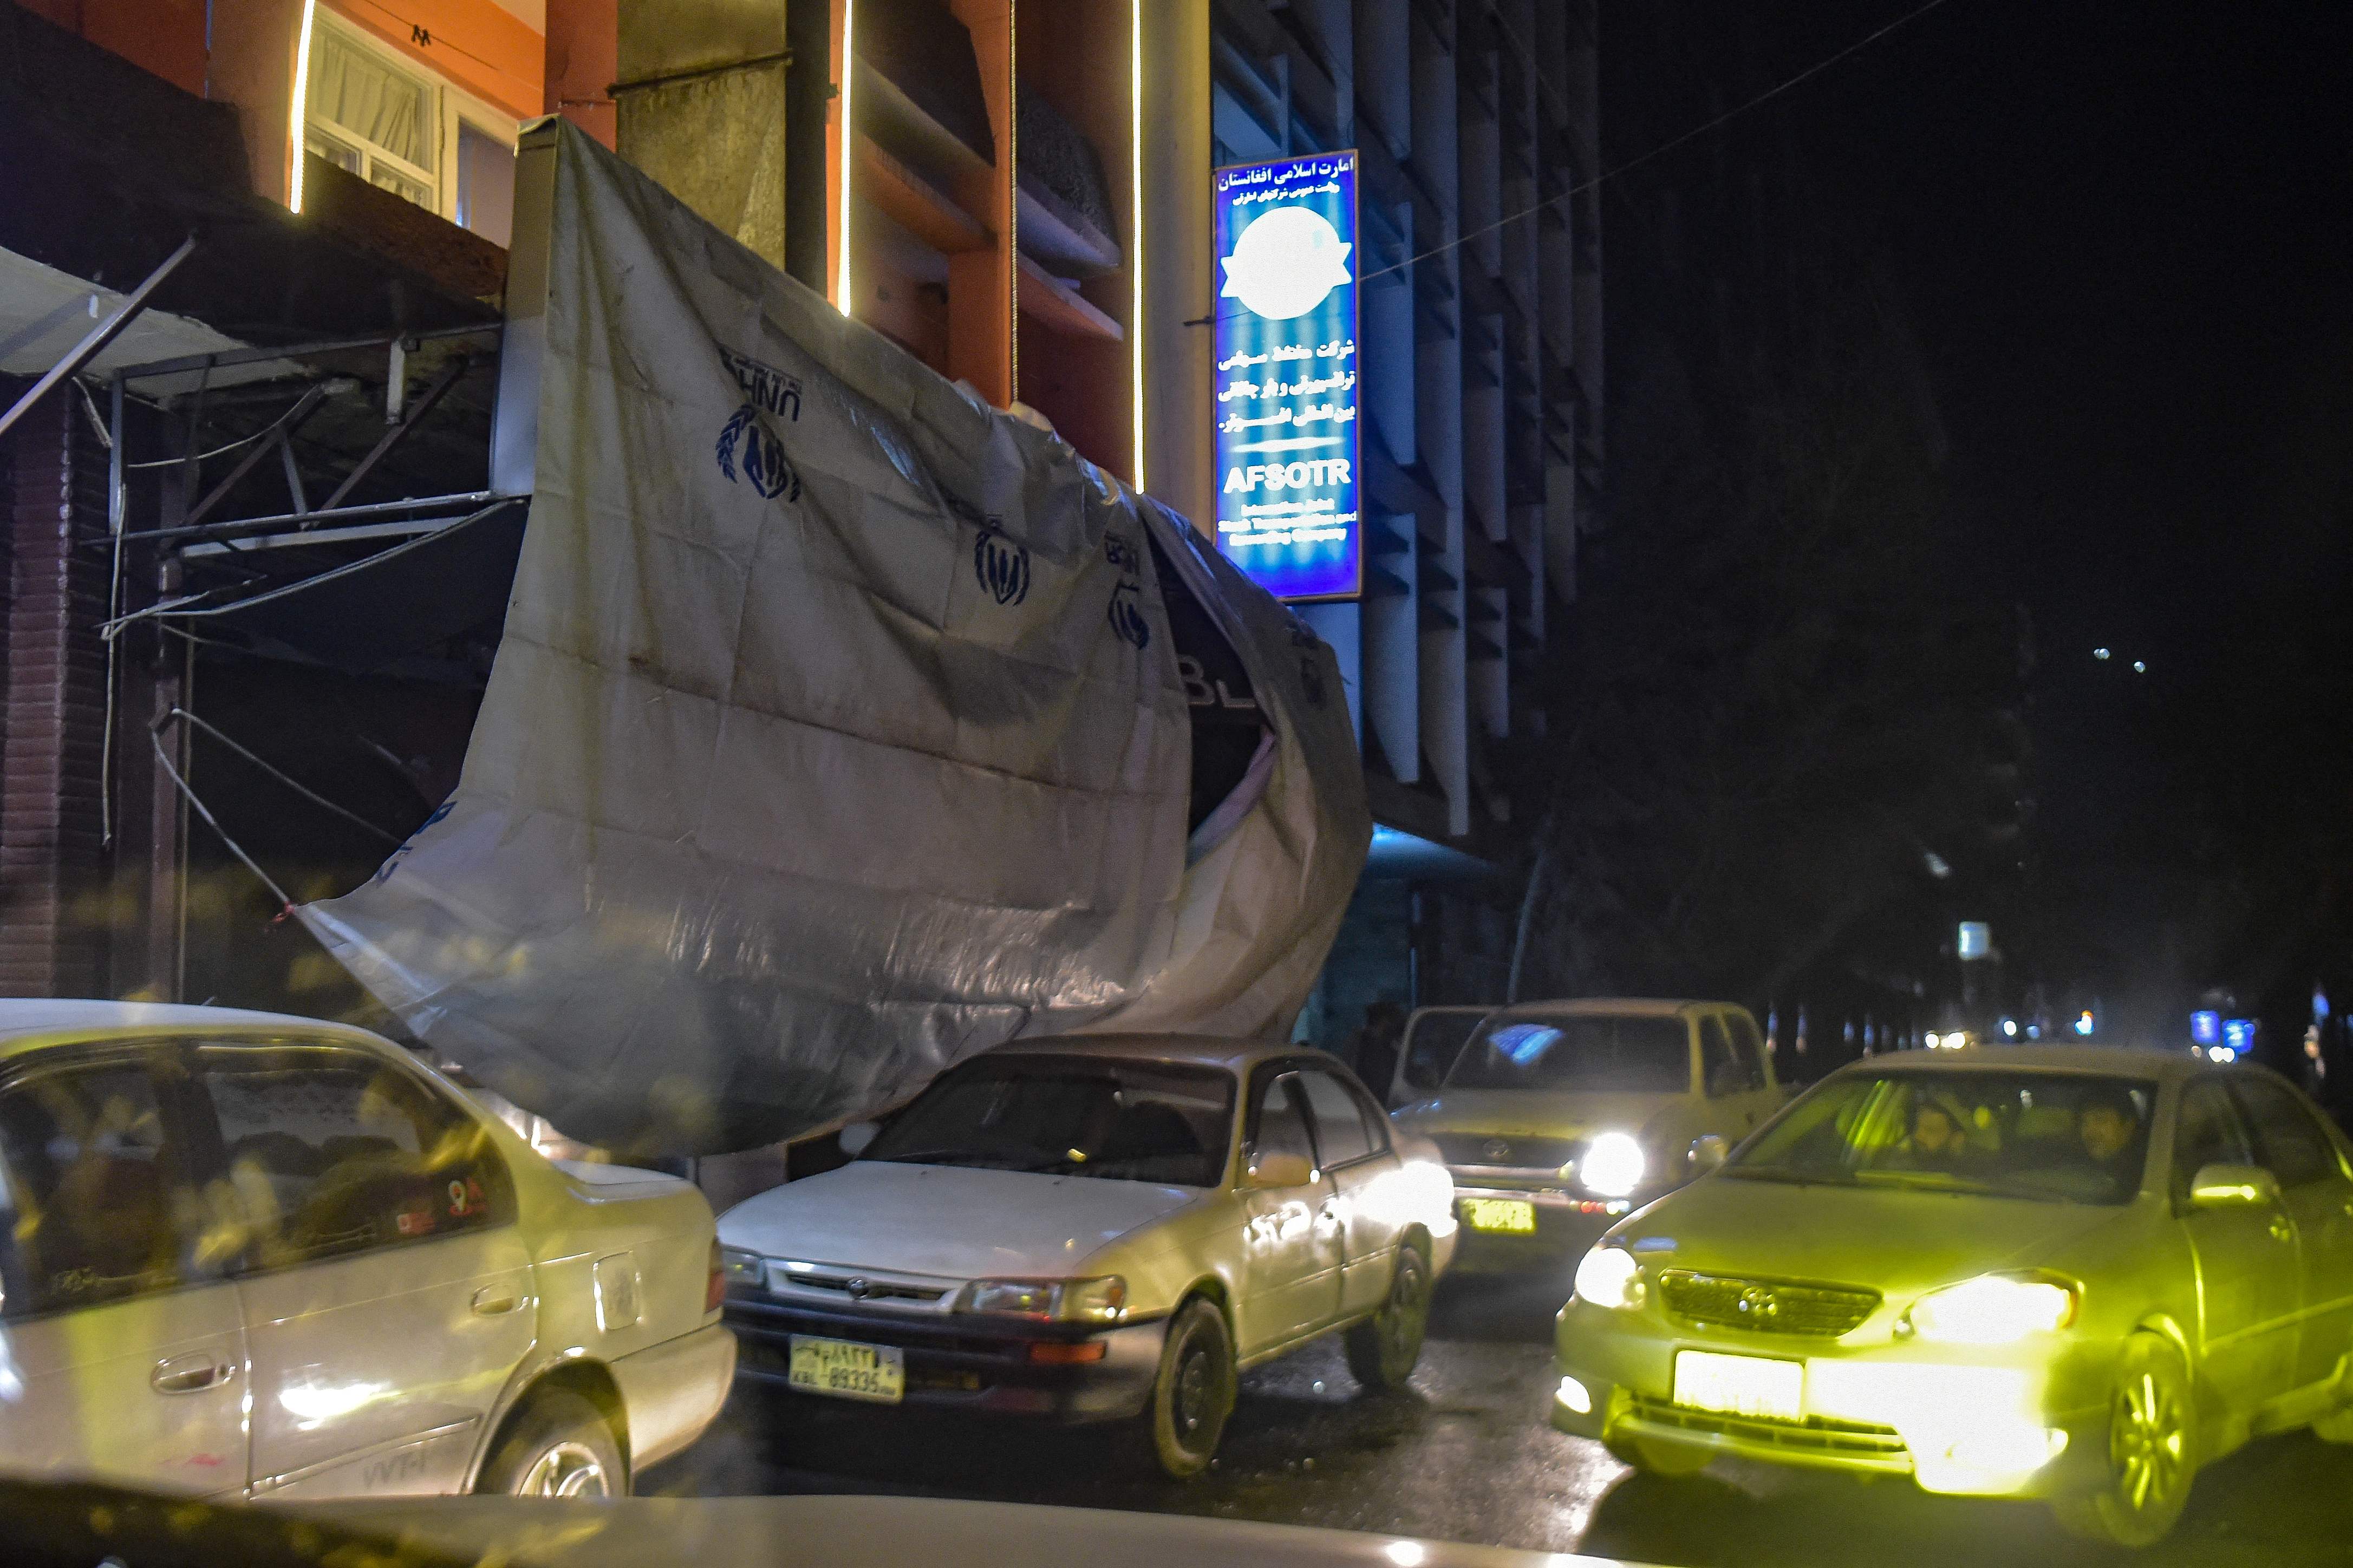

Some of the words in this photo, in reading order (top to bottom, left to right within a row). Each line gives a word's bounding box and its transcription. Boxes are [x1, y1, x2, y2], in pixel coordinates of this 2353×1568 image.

[1274, 162, 1315, 184] اسلامی
[1318, 156, 1354, 178] امارت
[1218, 167, 1272, 191] افغانستان
[1223, 458, 1352, 494] AFSOTR
